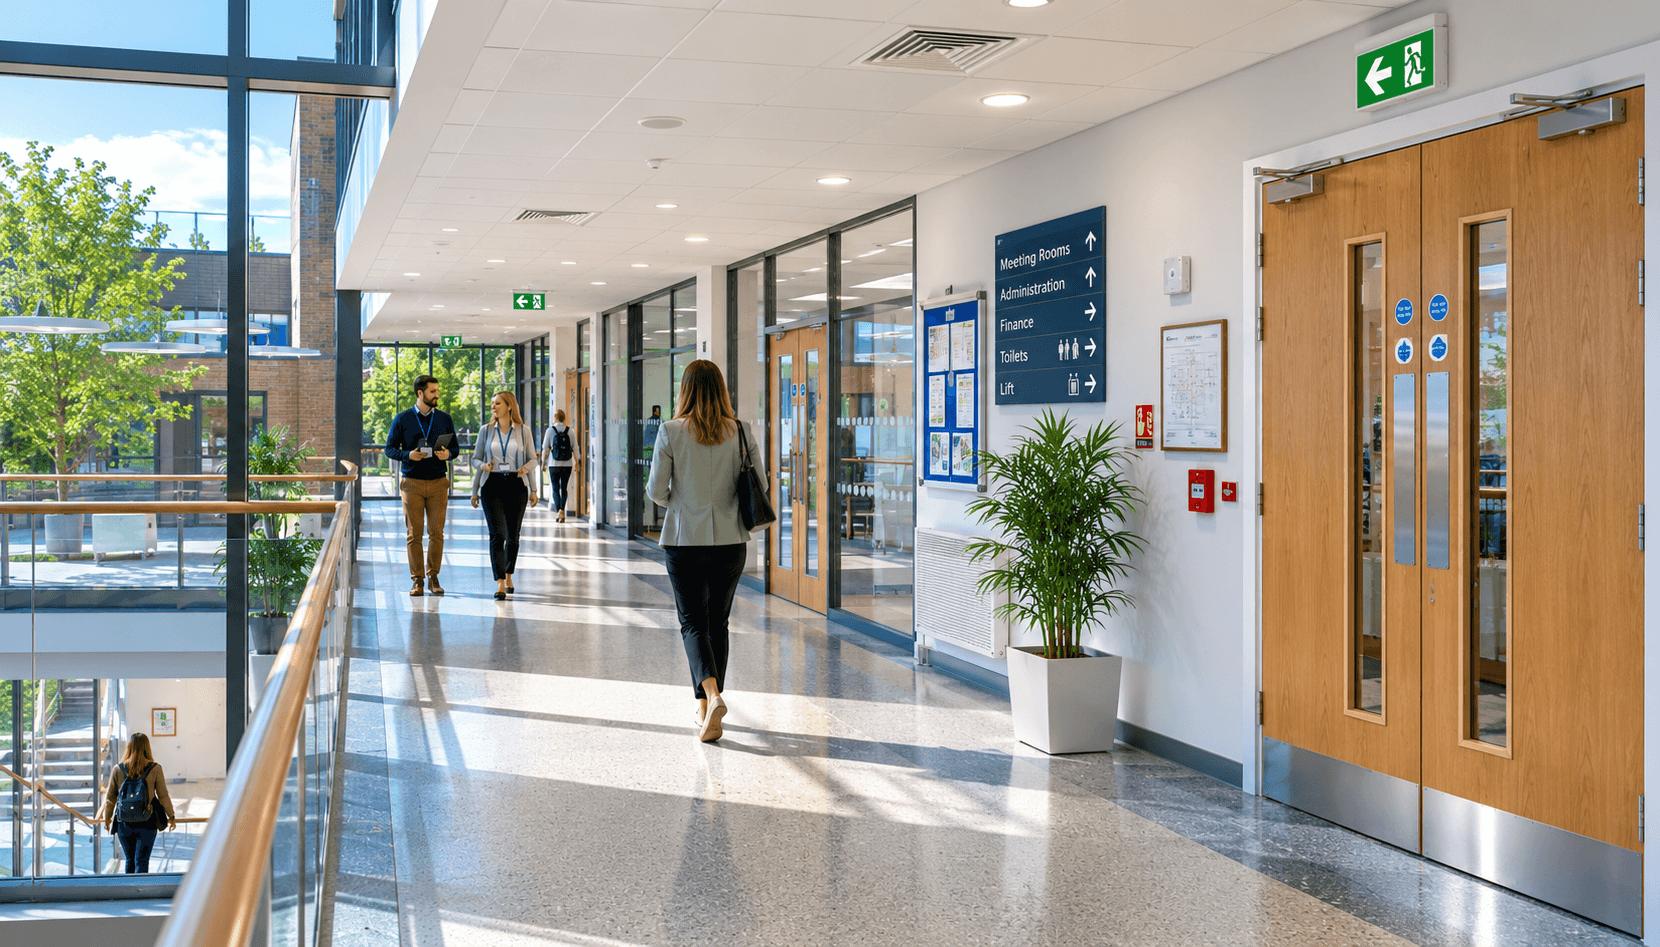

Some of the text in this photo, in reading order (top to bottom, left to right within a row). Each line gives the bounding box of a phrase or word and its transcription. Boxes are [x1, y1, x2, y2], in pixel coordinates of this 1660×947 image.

[1000, 244, 1071, 271] Meeting Rooms
[1000, 278, 1065, 301] Administration
[1000, 318, 1034, 332] Finance
[1000, 350, 1028, 363] Toilets
[1000, 382, 1014, 395] Lift
